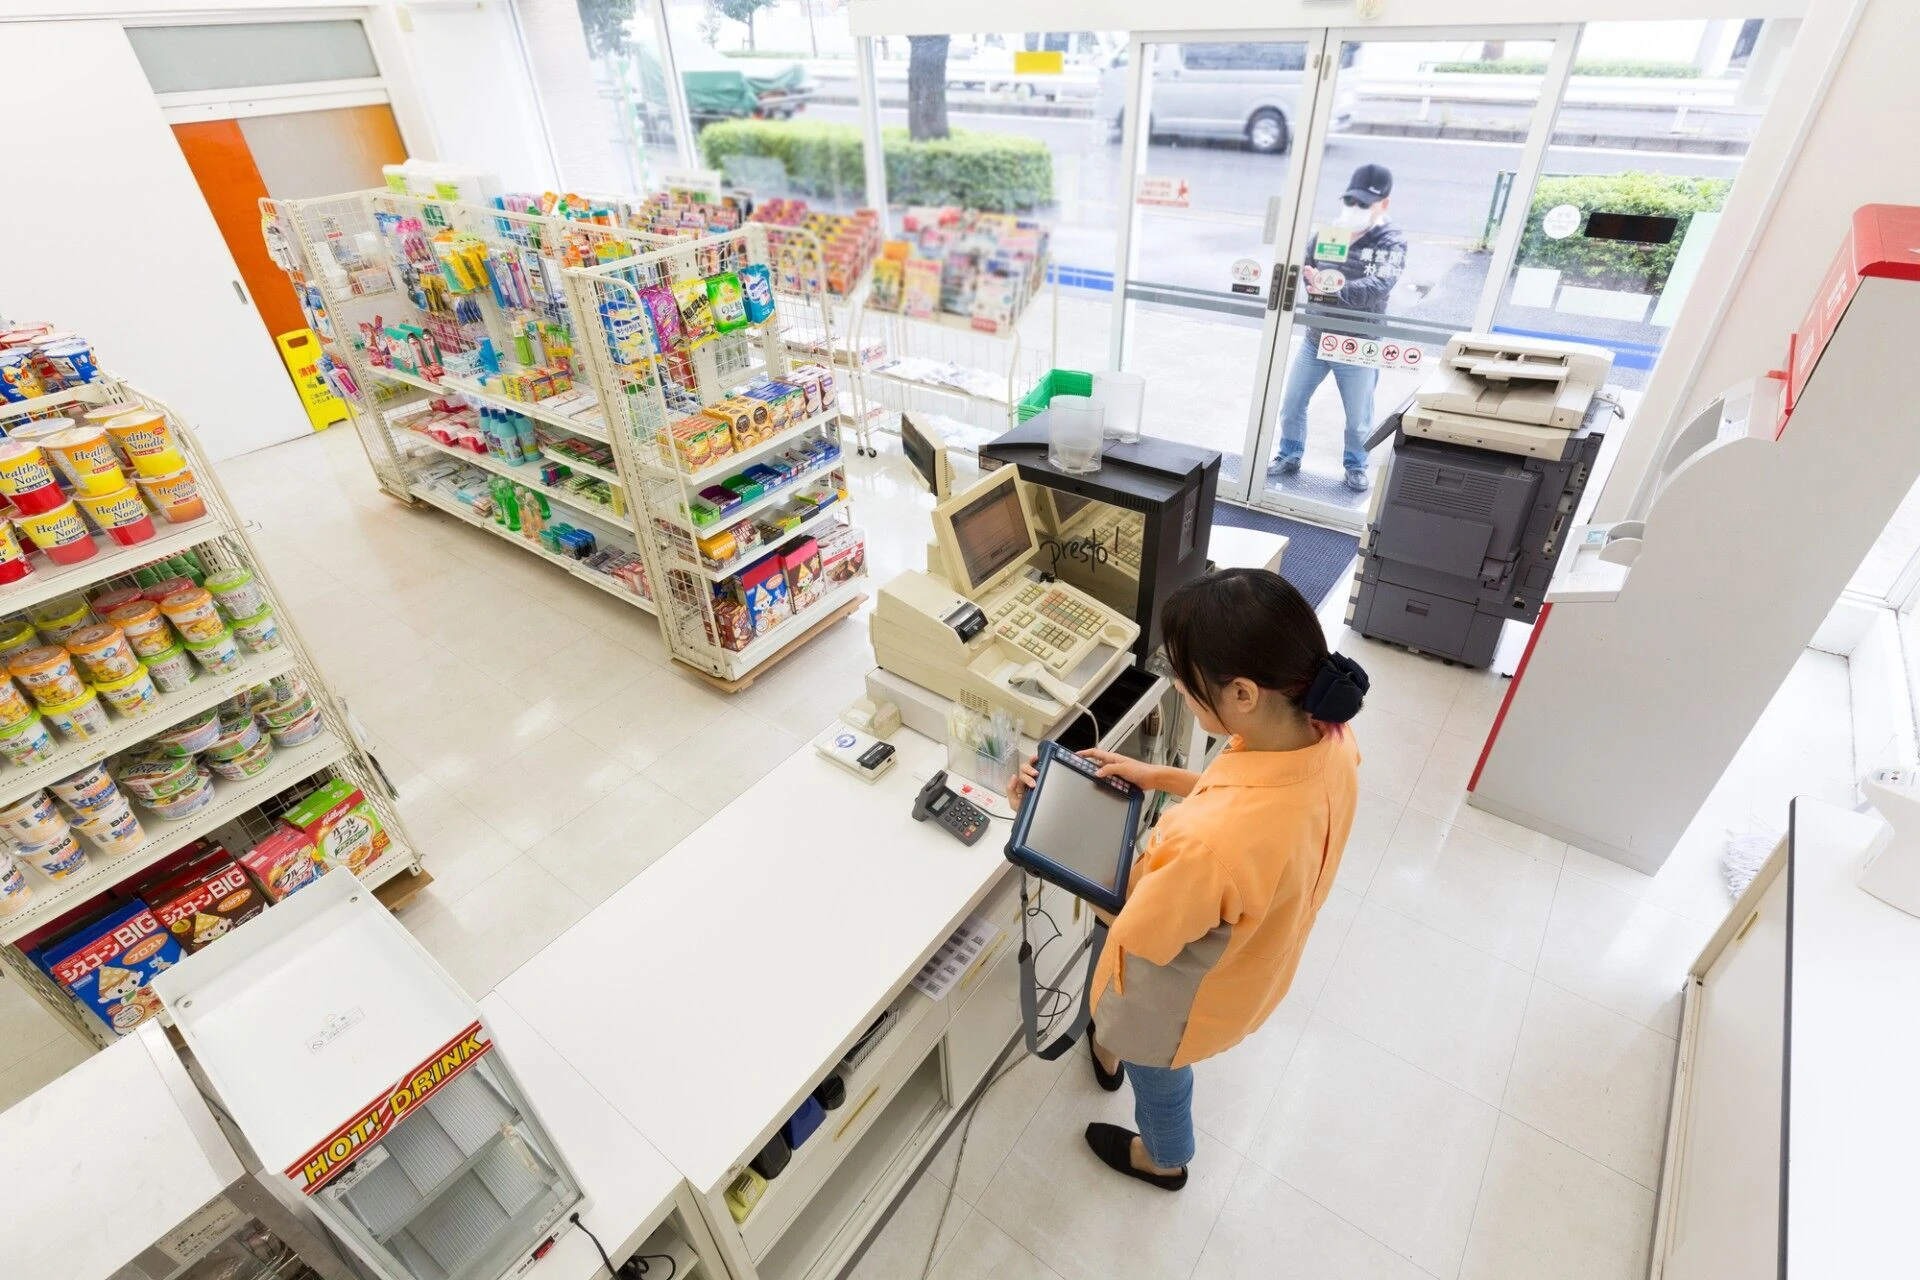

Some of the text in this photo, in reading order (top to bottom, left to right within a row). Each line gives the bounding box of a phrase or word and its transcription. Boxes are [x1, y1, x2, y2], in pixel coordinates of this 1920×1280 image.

[158, 480, 192, 496] Healthy
[95, 497, 137, 516] Healthy
[36, 515, 78, 535] Healthy
[74, 776, 99, 791] BIG
[32, 792, 48, 809] BIG
[110, 811, 130, 828] BIG
[48, 837, 72, 856] BIG
[2, 864, 17, 882] BIG
[280, 857, 313, 887] フルーツ
[161, 893, 213, 926] シスコーン
[207, 867, 247, 900] BIG
[61, 911, 159, 983] シスコーン BIG
[129, 937, 163, 962] フロスト
[303, 1109, 384, 1185] HOT!
[388, 1031, 484, 1117] DRINK
